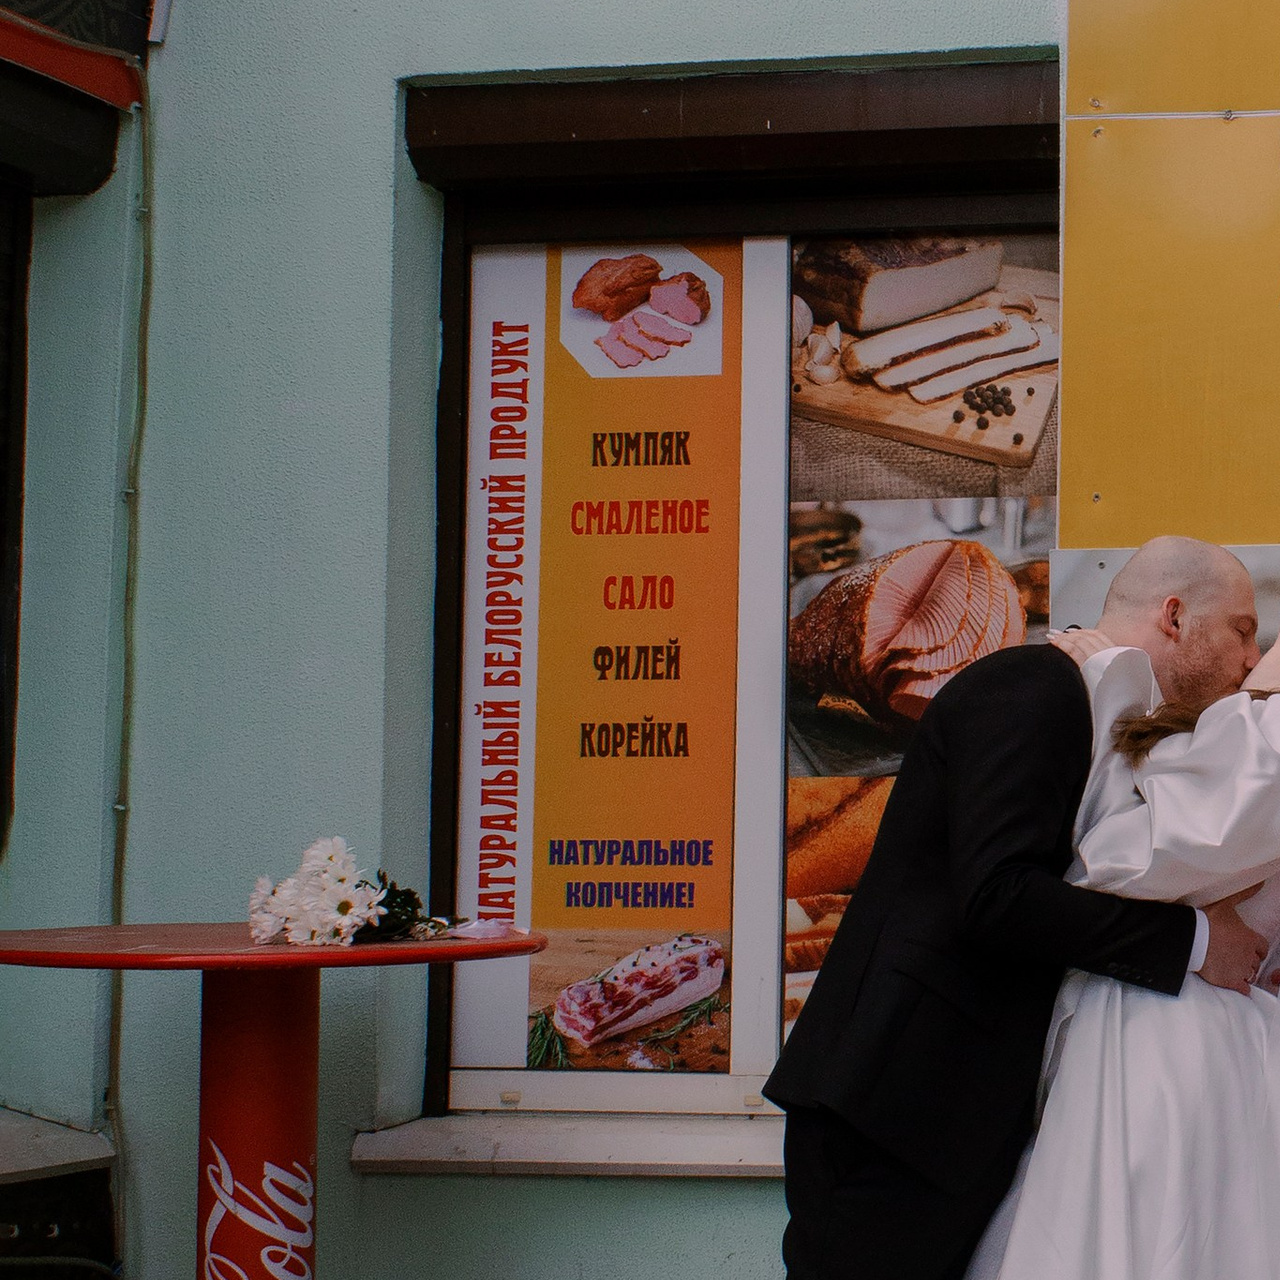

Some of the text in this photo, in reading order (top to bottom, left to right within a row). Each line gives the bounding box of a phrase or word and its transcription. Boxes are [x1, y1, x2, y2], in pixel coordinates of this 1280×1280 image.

[489, 320, 530, 460] ПРОДУКТ
[591, 431, 691, 467] КУМПЯК
[570, 499, 710, 536] СМАЛЕНОЕ
[480, 473, 526, 687] БЕЛОРУССКИЙ
[603, 575, 675, 610] САЛО
[593, 637, 681, 680] ФИЛЕЙ
[580, 715, 690, 757] КОРЕЙКА
[549, 839, 713, 866] НАТУРАЛЬНОЕ
[566, 882, 695, 908] КОПЧЕНИЕ!
